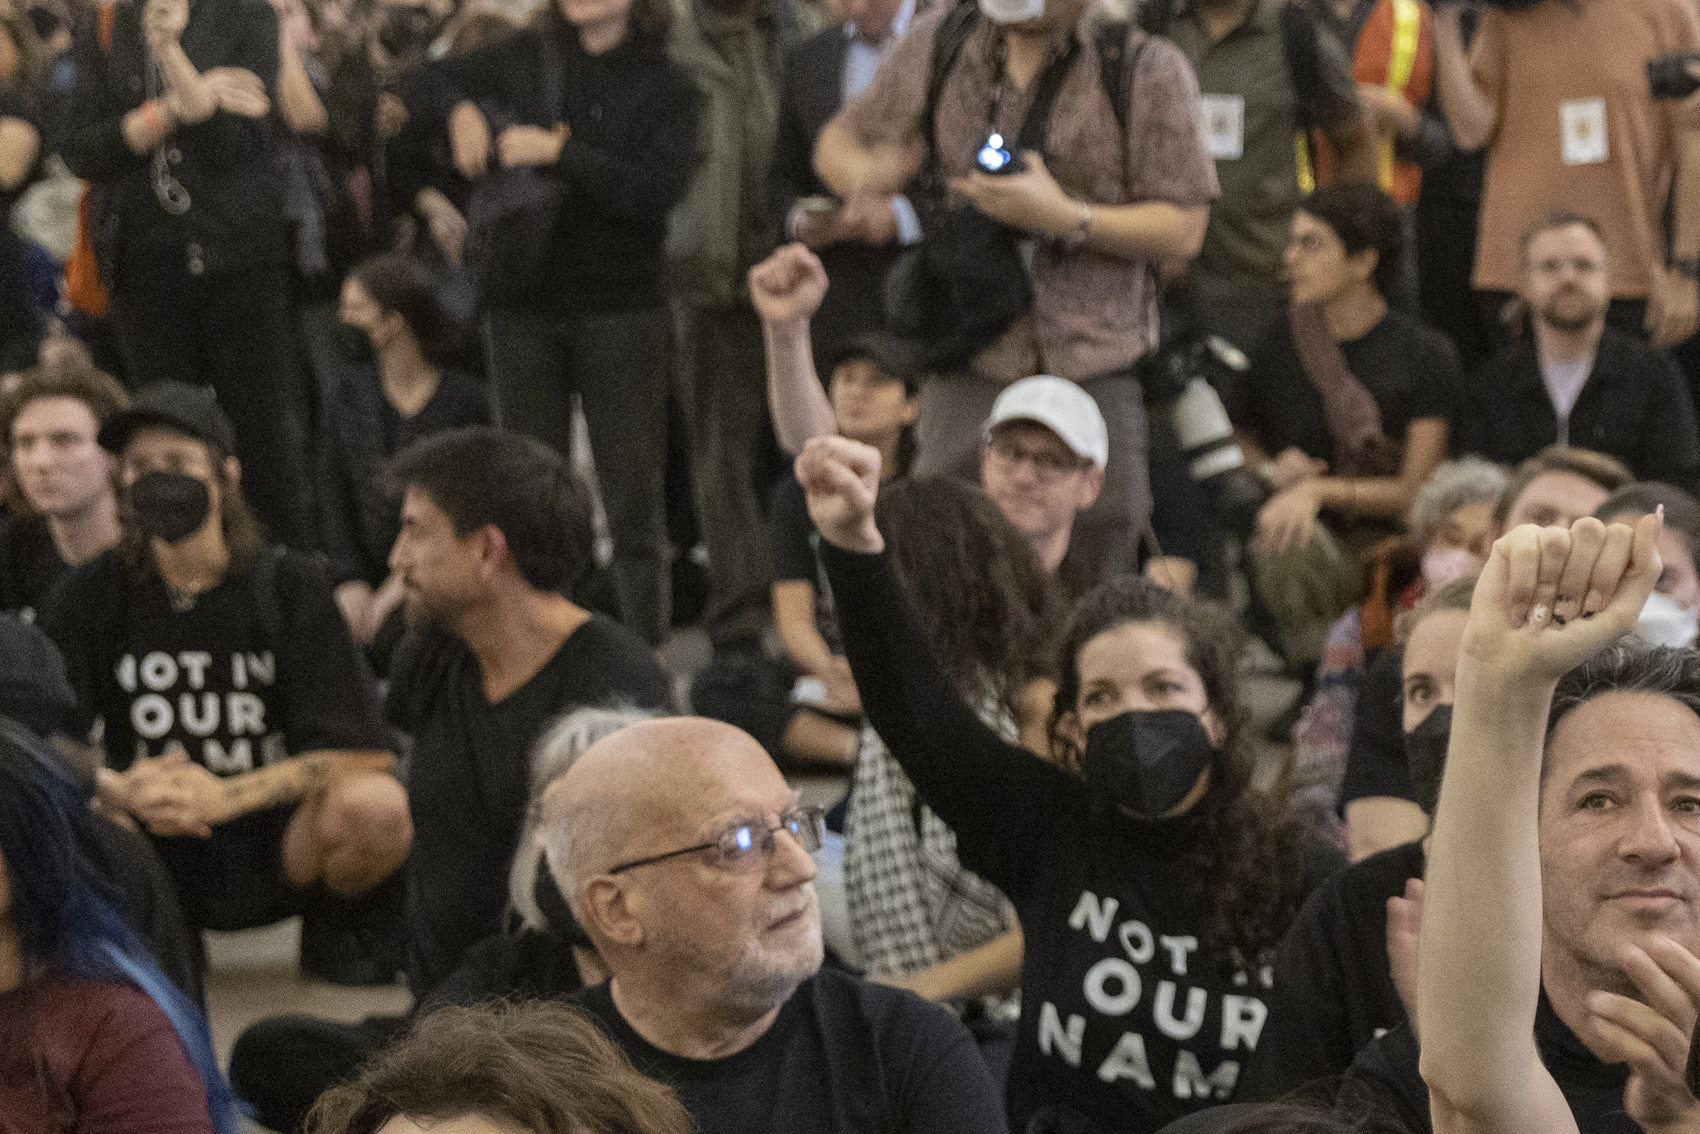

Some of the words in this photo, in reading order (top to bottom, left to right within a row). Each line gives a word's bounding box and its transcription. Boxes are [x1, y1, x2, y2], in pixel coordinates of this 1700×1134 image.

[130, 691, 267, 740] OUR
[1068, 889, 1198, 976] NOT
[1083, 956, 1268, 1040] OUR
[1038, 1001, 1240, 1098] NAM
